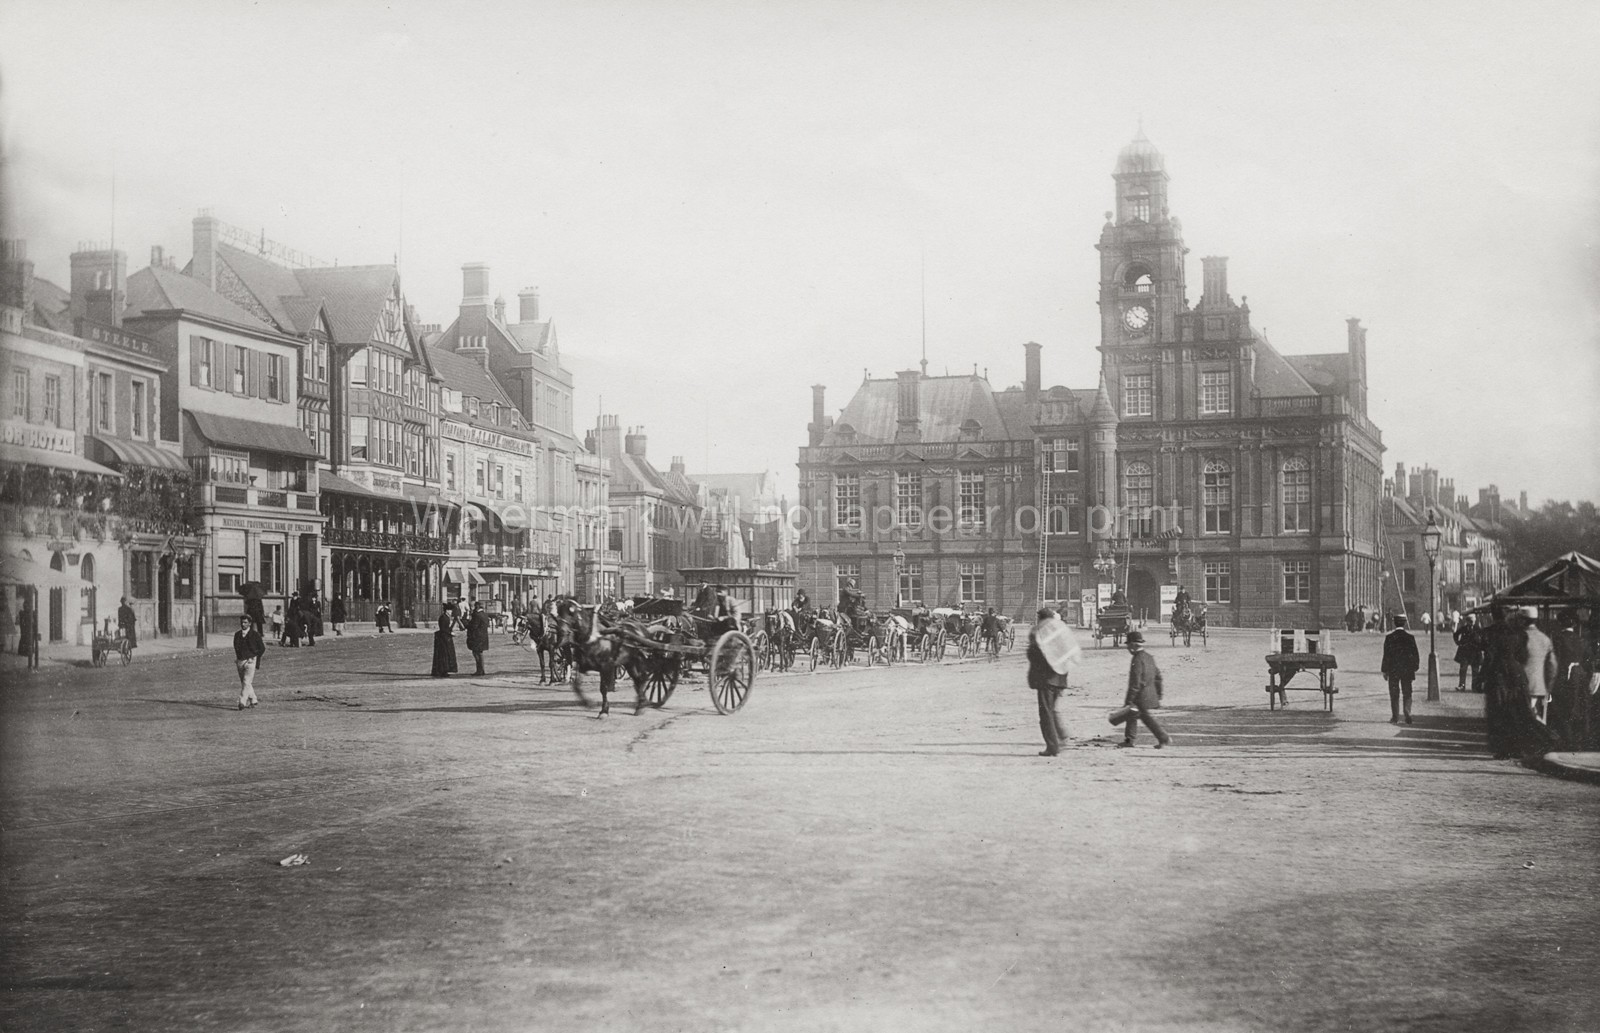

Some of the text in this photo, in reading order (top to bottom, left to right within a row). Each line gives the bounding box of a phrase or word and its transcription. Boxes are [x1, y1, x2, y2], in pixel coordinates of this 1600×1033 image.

[30, 430, 73, 453] HOTEL
[223, 518, 313, 532] NATIONAL PROVINCIAL BANK OF ENGLAND
